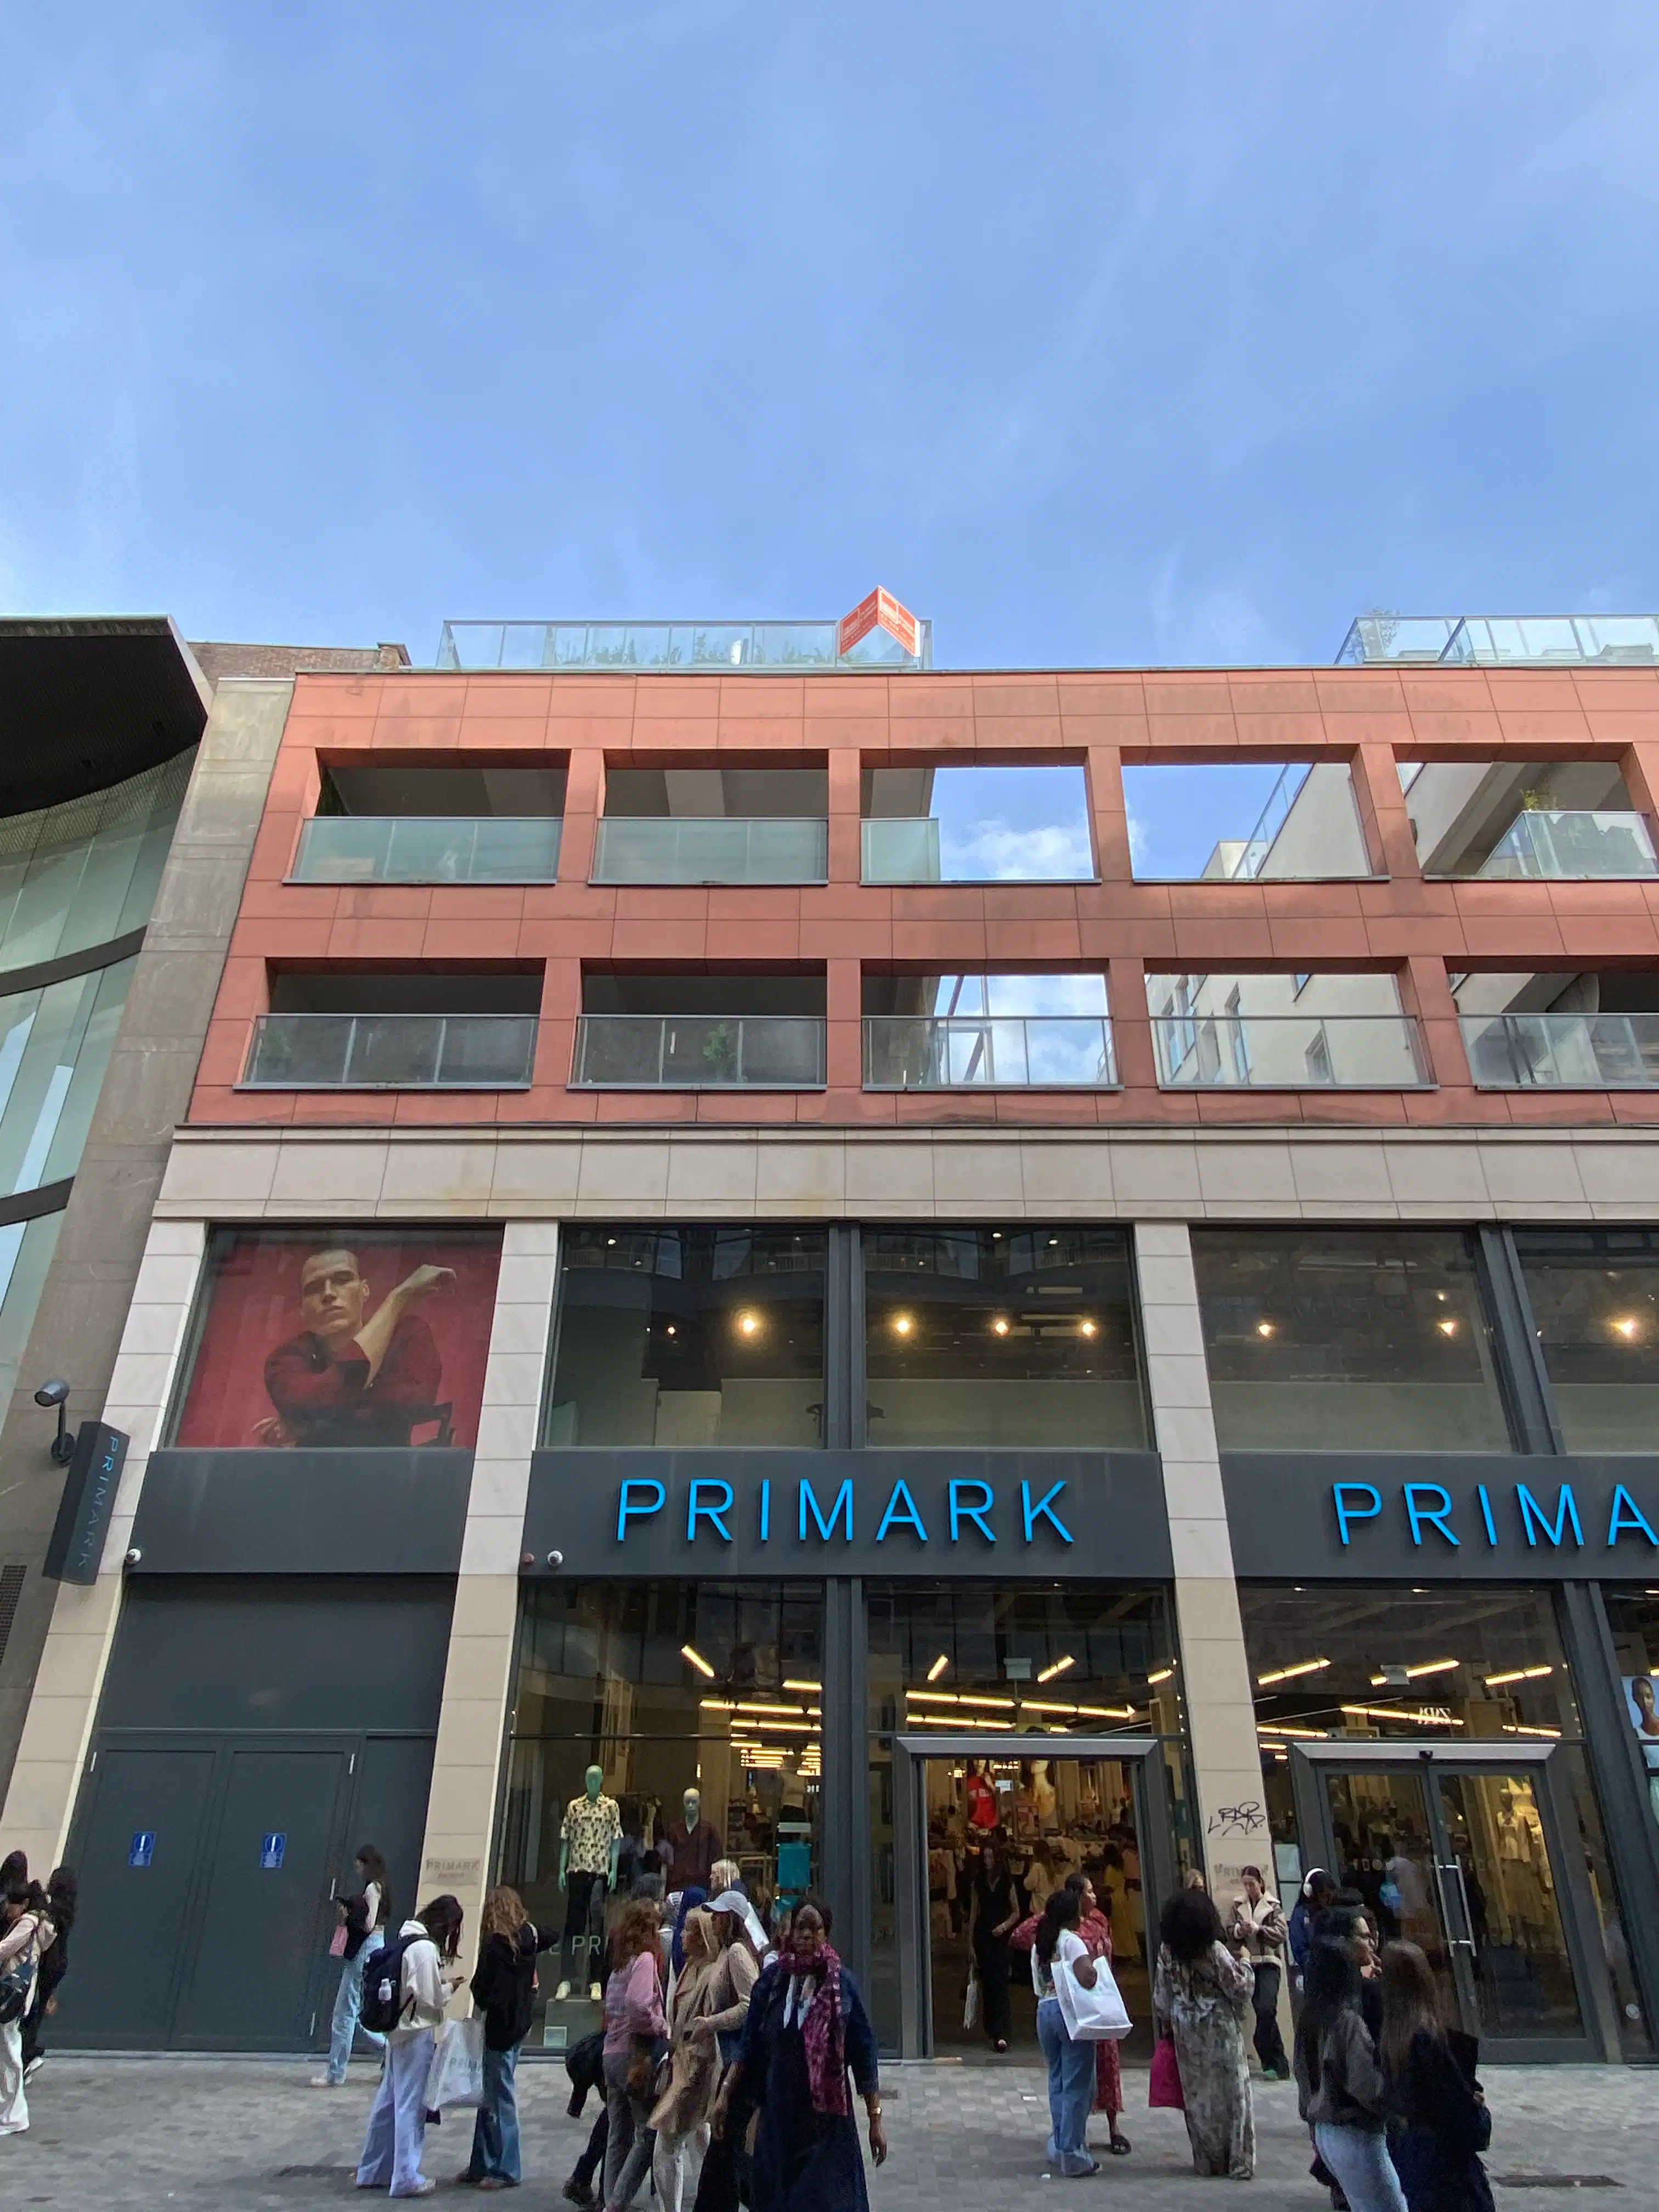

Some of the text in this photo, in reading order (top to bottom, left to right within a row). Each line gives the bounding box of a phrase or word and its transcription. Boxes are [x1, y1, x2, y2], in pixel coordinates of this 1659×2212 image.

[77, 1435, 119, 1567] PRIMARK
[616, 1477, 1075, 1542] PRIMARK
[1333, 1482, 1659, 1545] PRIMA
[426, 1860, 481, 1870] PRIMARK
